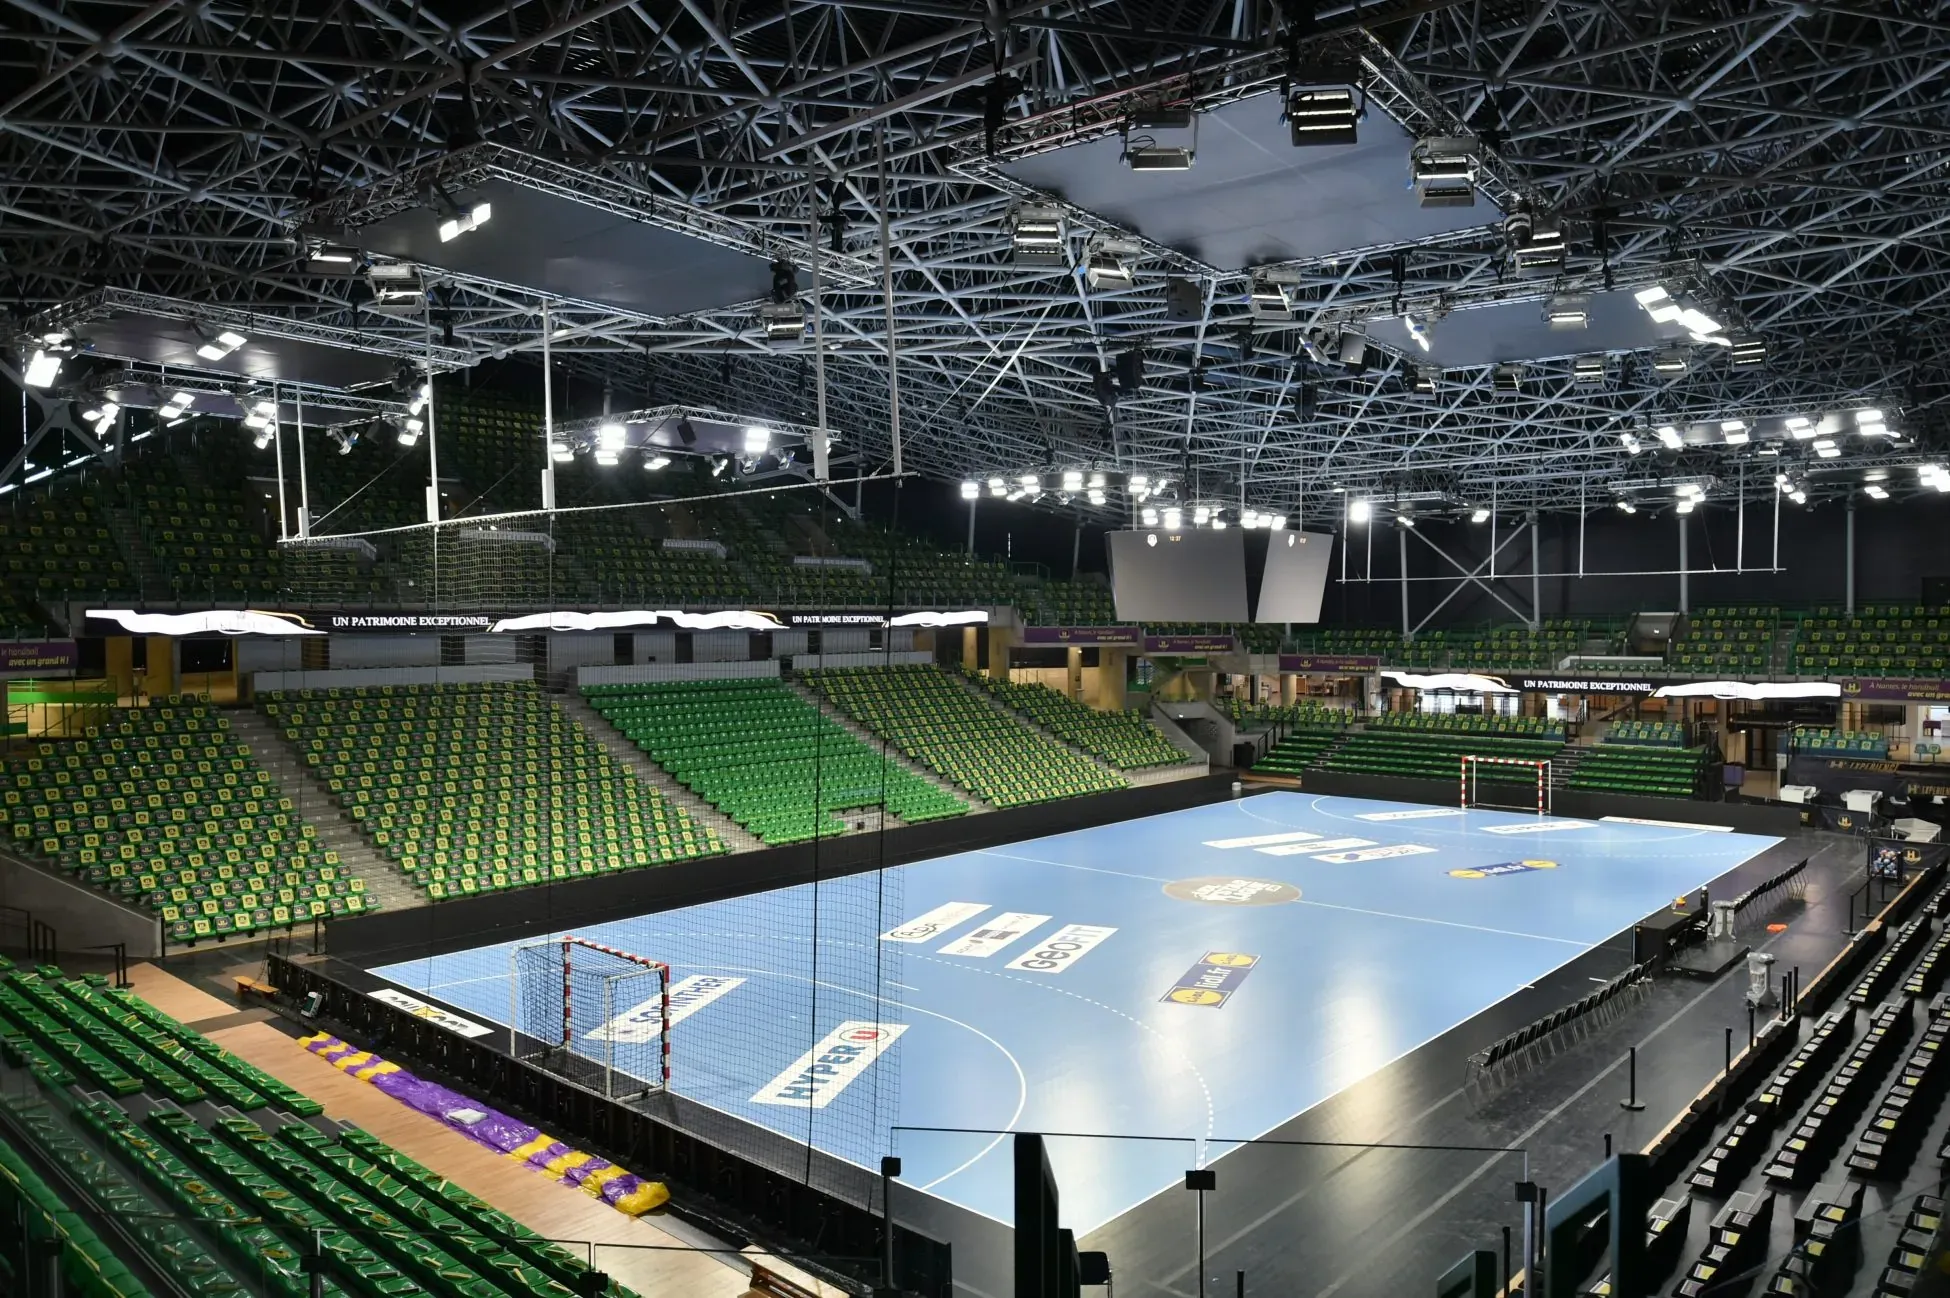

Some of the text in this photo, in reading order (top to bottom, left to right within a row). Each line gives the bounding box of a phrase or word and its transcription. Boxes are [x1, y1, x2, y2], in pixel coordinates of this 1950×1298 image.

[332, 616, 491, 627] UN PATRIMOINE EXCEPTIONNEL
[37, 656, 59, 666] grand
[1524, 680, 1653, 692] UN PATRIMOINE EXCEPTIONNEL
[1193, 967, 1232, 989] lidl.fr
[776, 1030, 879, 1100] HYPER U
